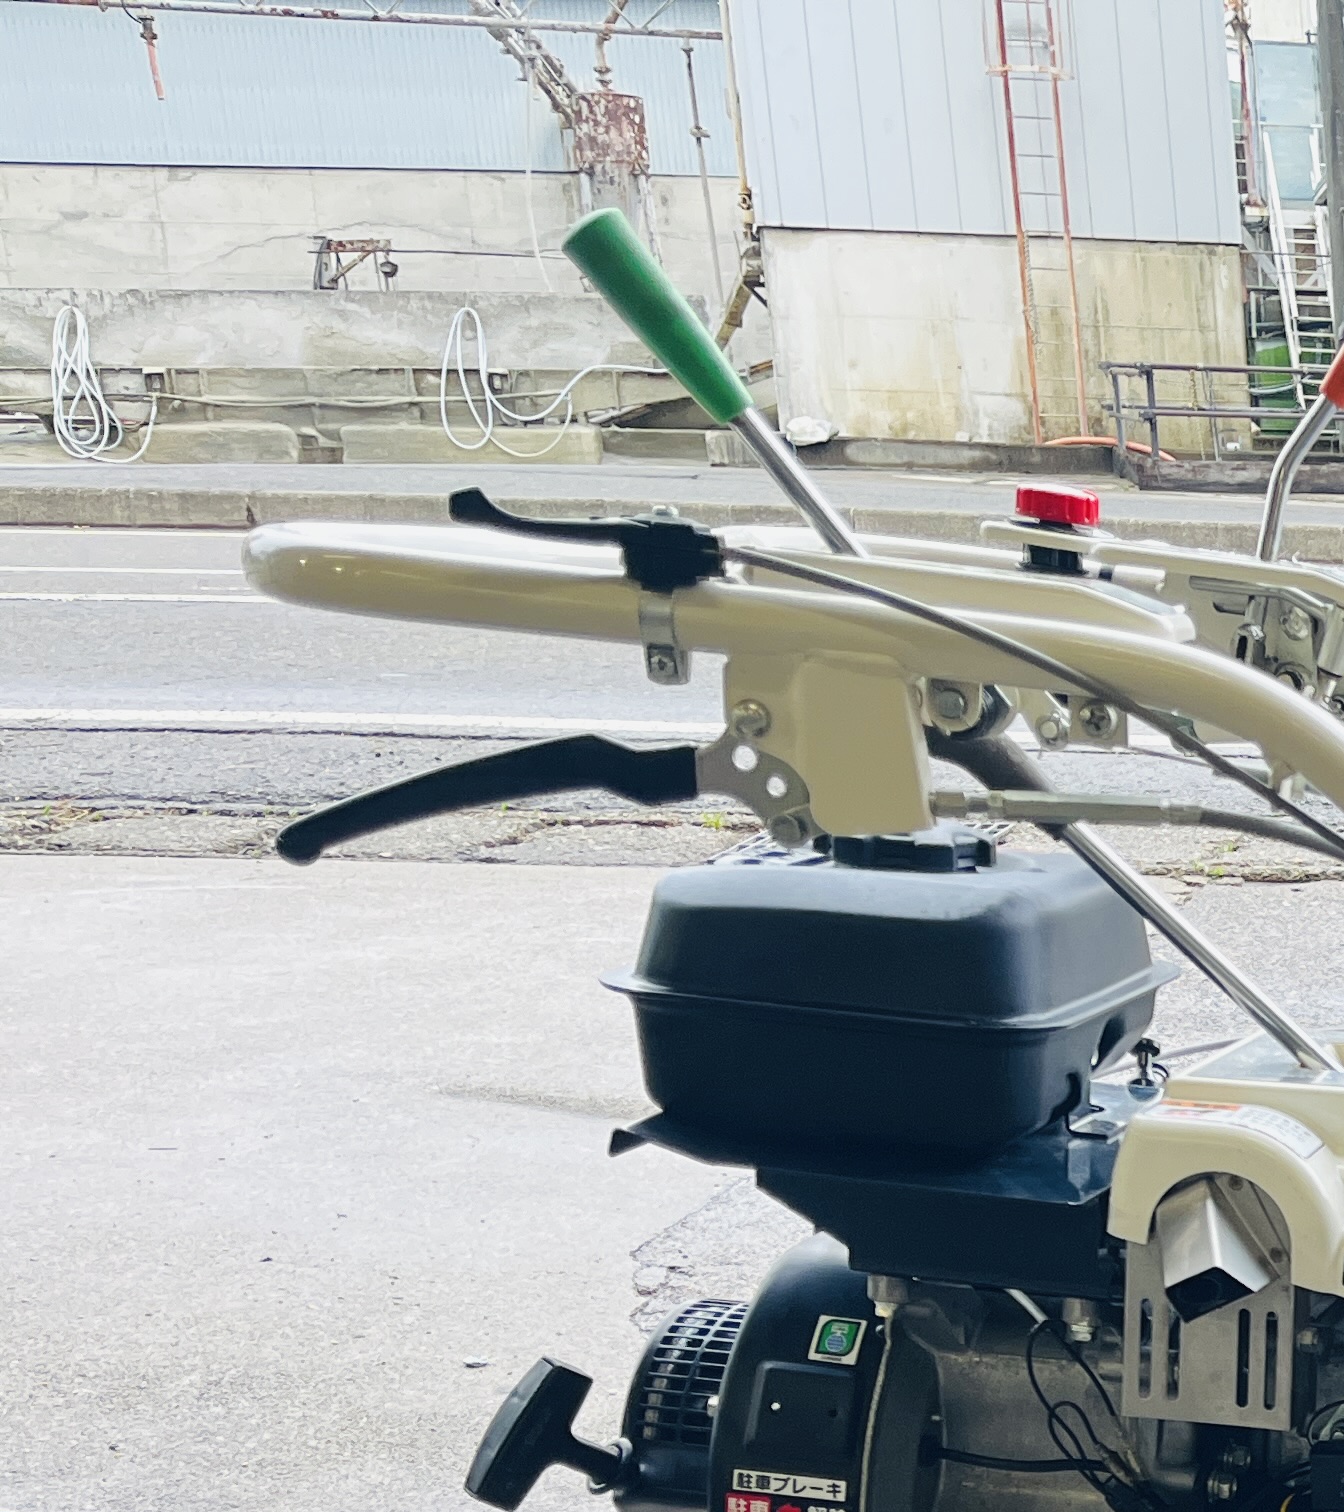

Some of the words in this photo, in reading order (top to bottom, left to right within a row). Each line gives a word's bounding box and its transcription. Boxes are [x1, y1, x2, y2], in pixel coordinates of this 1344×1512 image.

[736, 1471, 842, 1499] 駐車ブレーキ
